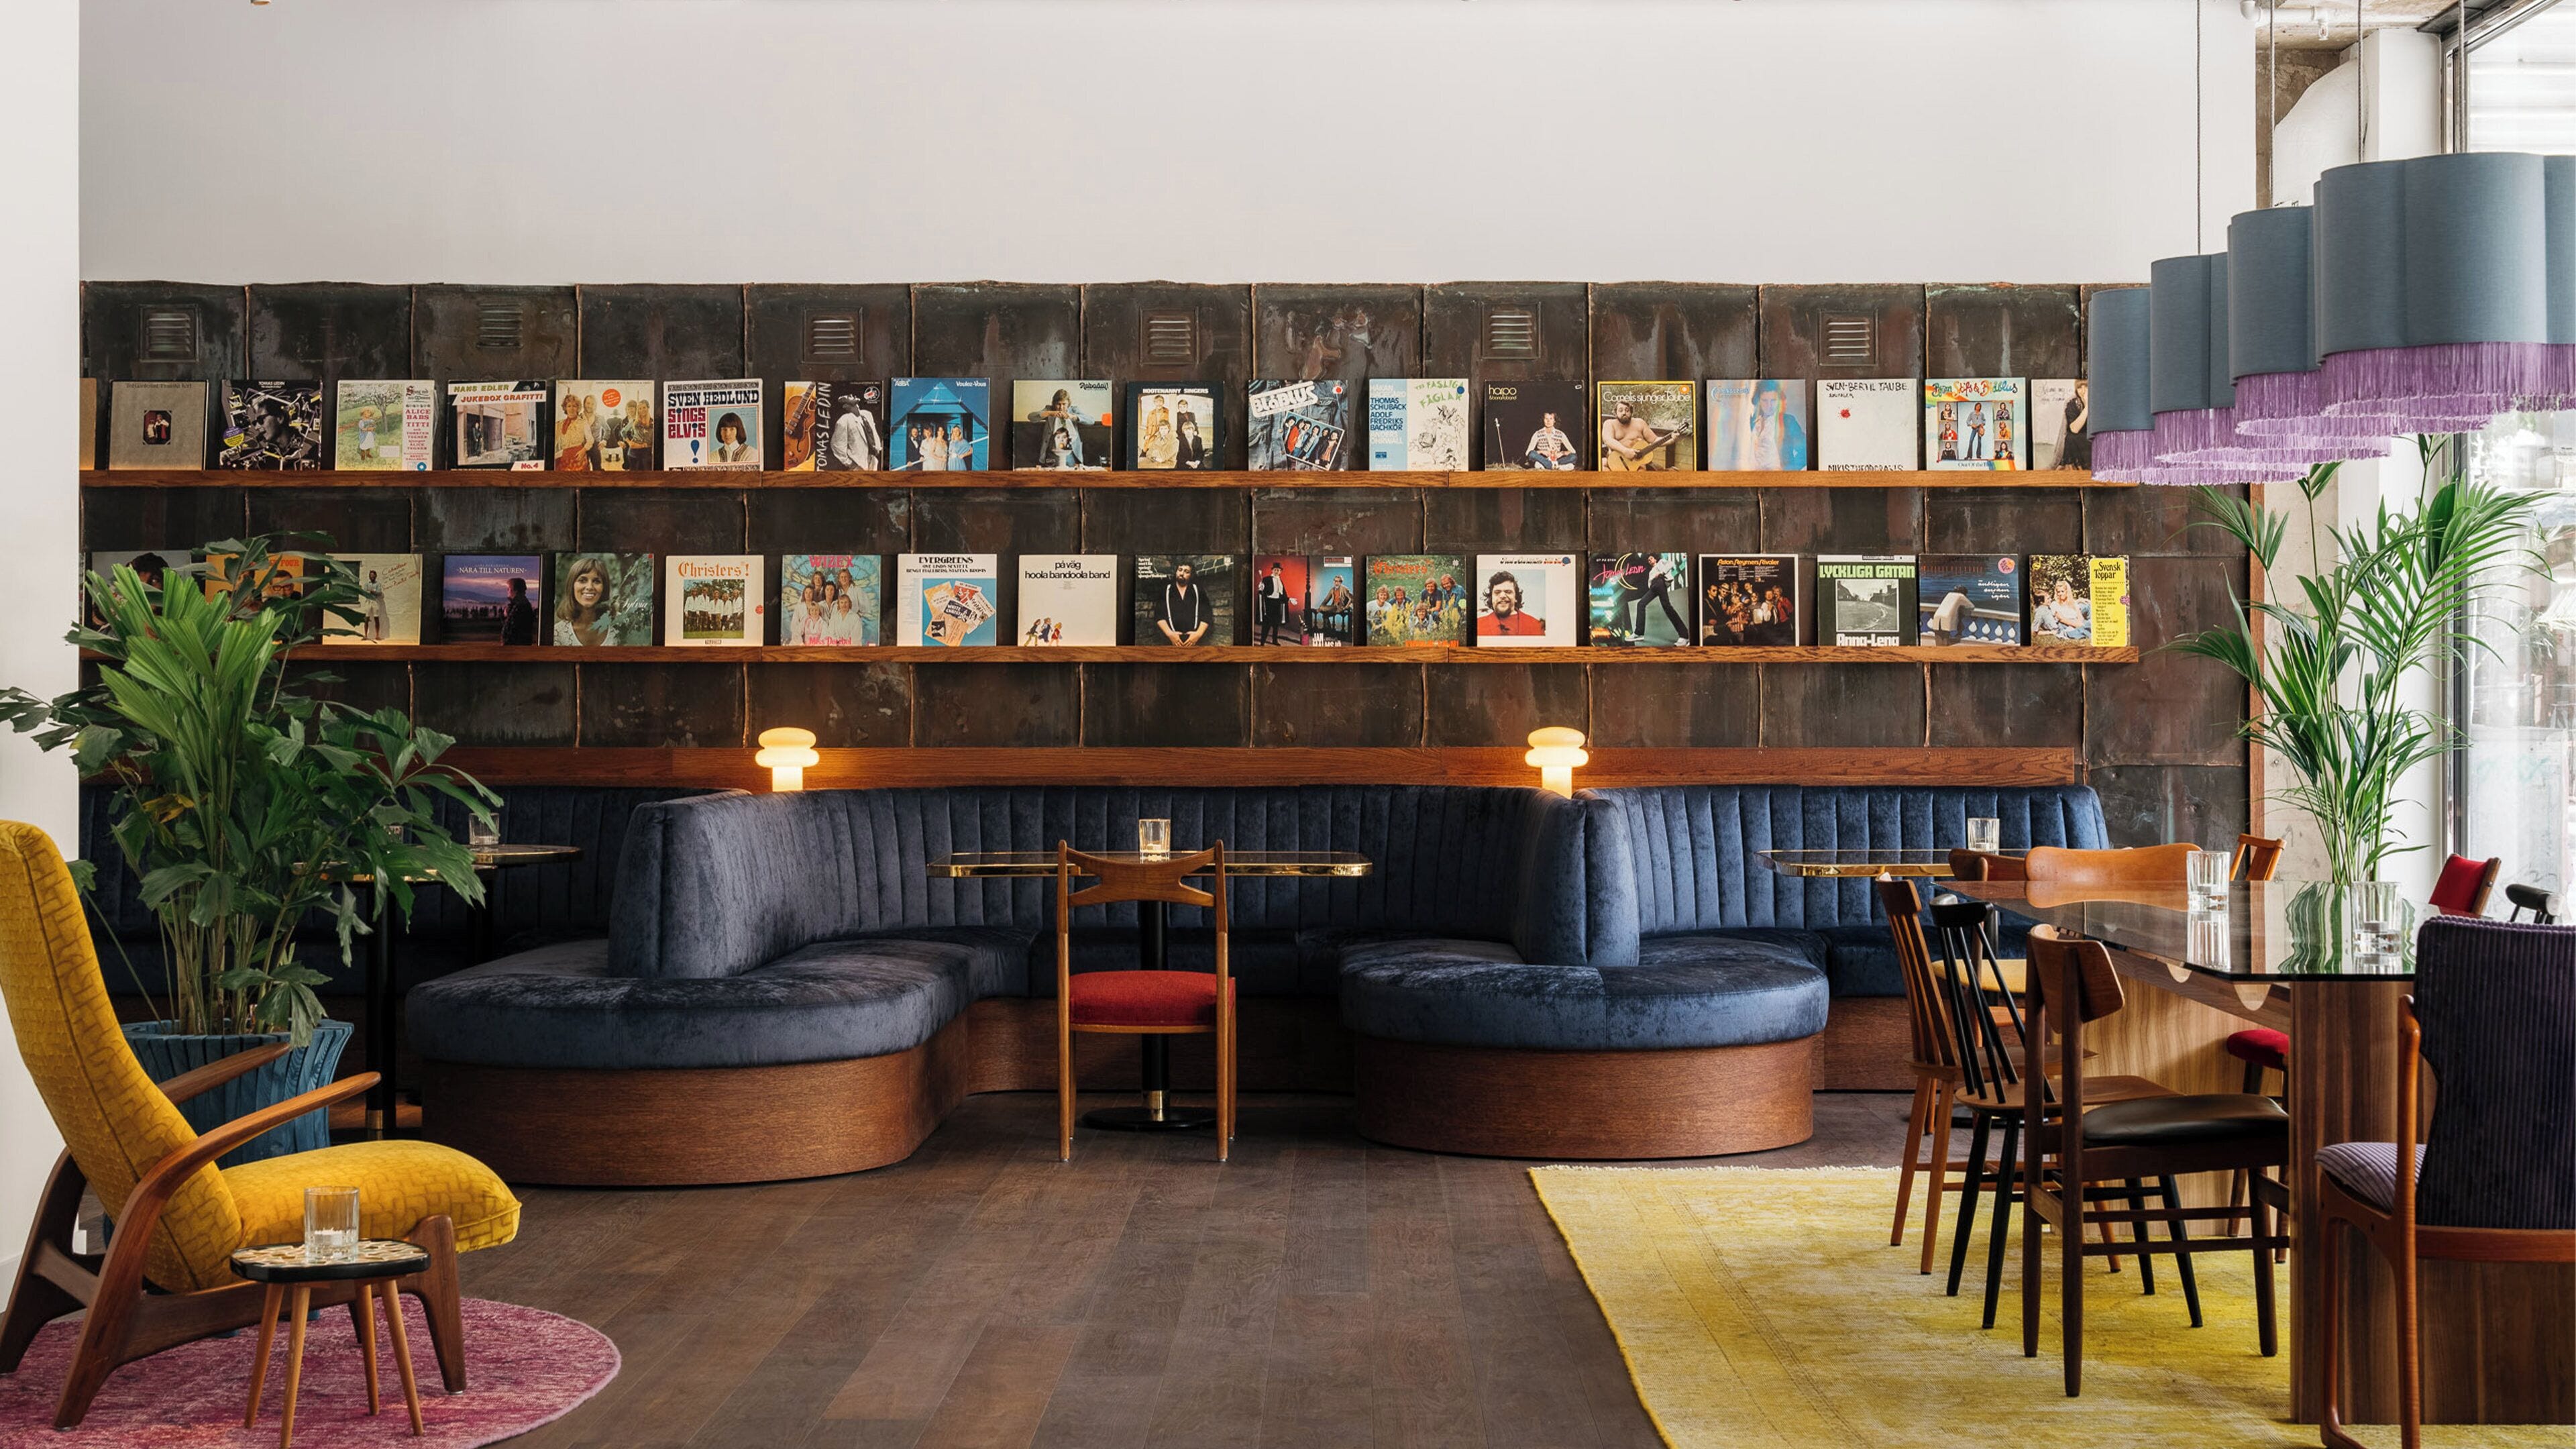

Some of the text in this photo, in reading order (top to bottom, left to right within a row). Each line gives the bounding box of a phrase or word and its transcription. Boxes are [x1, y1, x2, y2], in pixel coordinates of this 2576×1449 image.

[1489, 384, 1517, 397] harpo
[461, 394, 502, 402] JUKEBOX
[668, 390, 759, 407] SVEN HEDLUND
[1603, 390, 1637, 402] Cornelis
[1637, 393, 1665, 405] sjunger
[816, 382, 832, 472] TOMAS LEDIN
[808, 555, 854, 568] WIZEX
[1055, 560, 1081, 570] på väg
[2098, 561, 2121, 571] Svensk
[1024, 570, 1111, 579] hoola bandoola band
[1819, 565, 1915, 578] LYCKLIGA GATAN
[2094, 569, 2116, 581] Toppar
[1313, 633, 1324, 641] JAN
[1836, 633, 1900, 646] Anna-Lena
